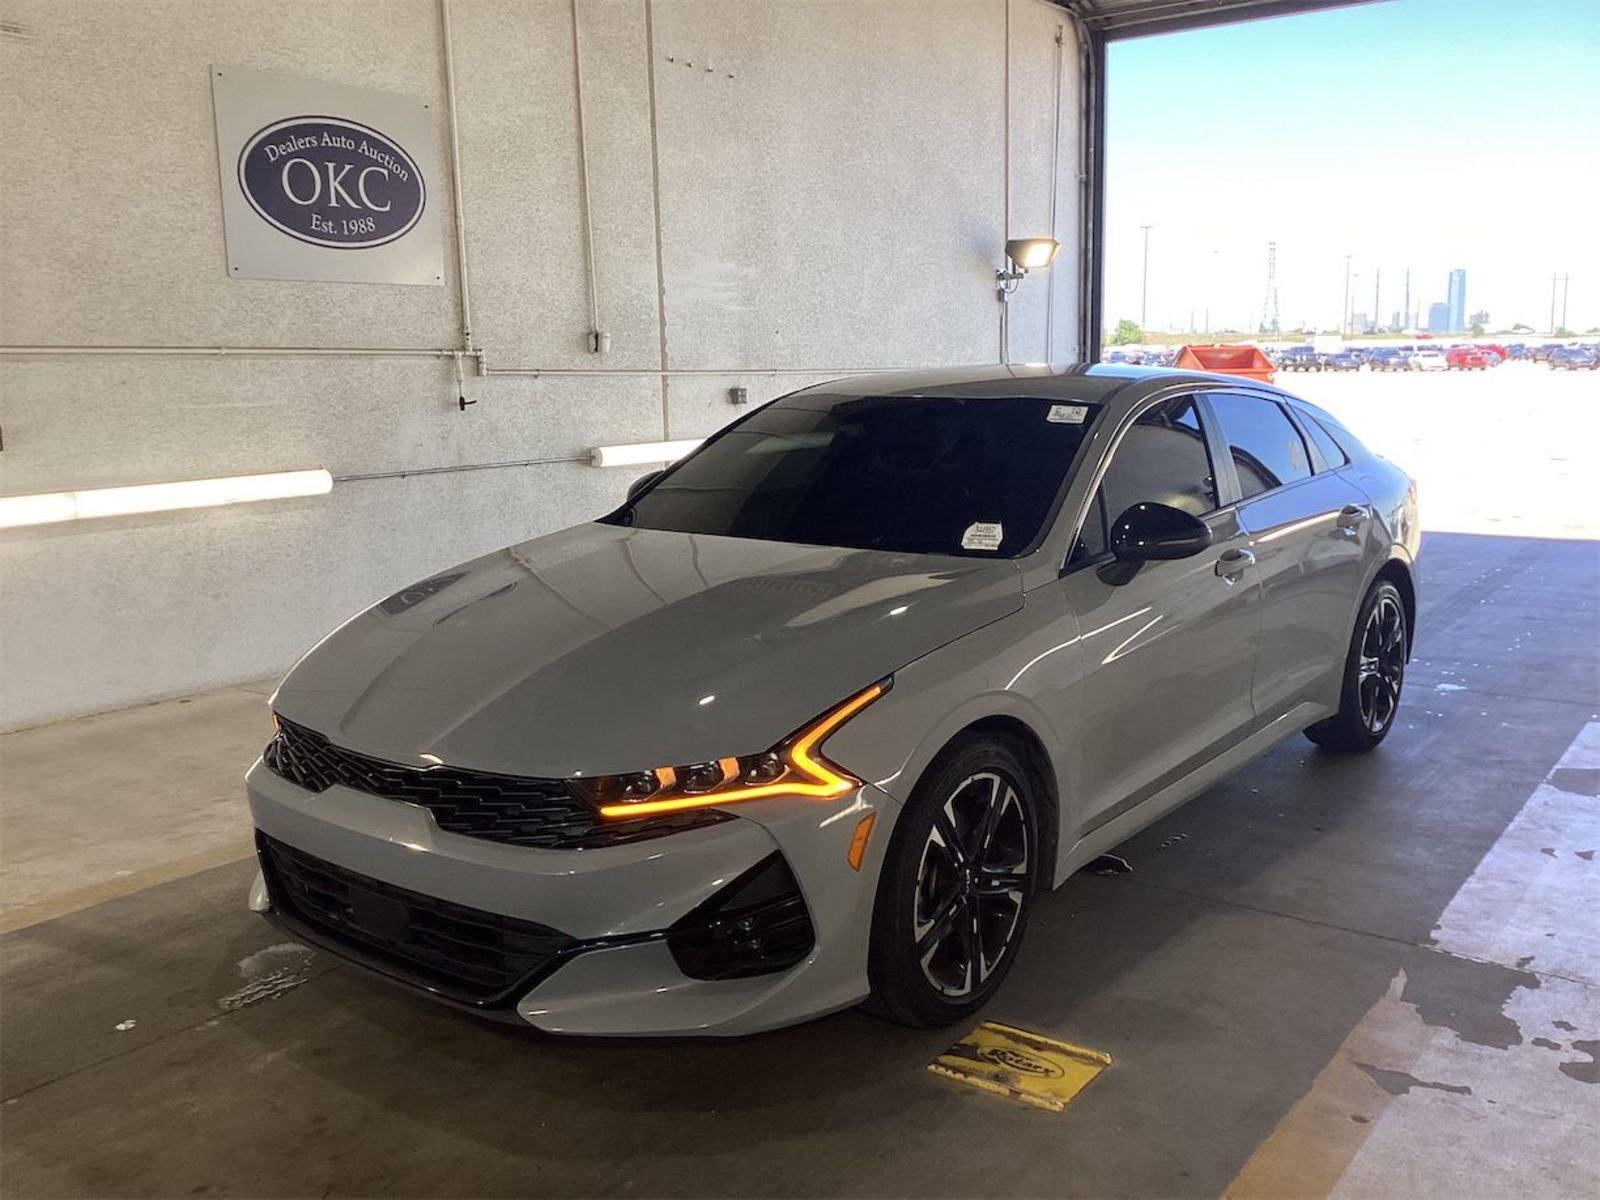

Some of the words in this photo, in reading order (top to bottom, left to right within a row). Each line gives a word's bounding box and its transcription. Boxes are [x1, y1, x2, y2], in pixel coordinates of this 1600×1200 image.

[265, 134, 318, 162] Dealers
[321, 132, 355, 150] Auto
[358, 141, 409, 181] Auction
[282, 158, 392, 212] OKC
[311, 214, 337, 234] Est.
[343, 217, 375, 236] 1988
